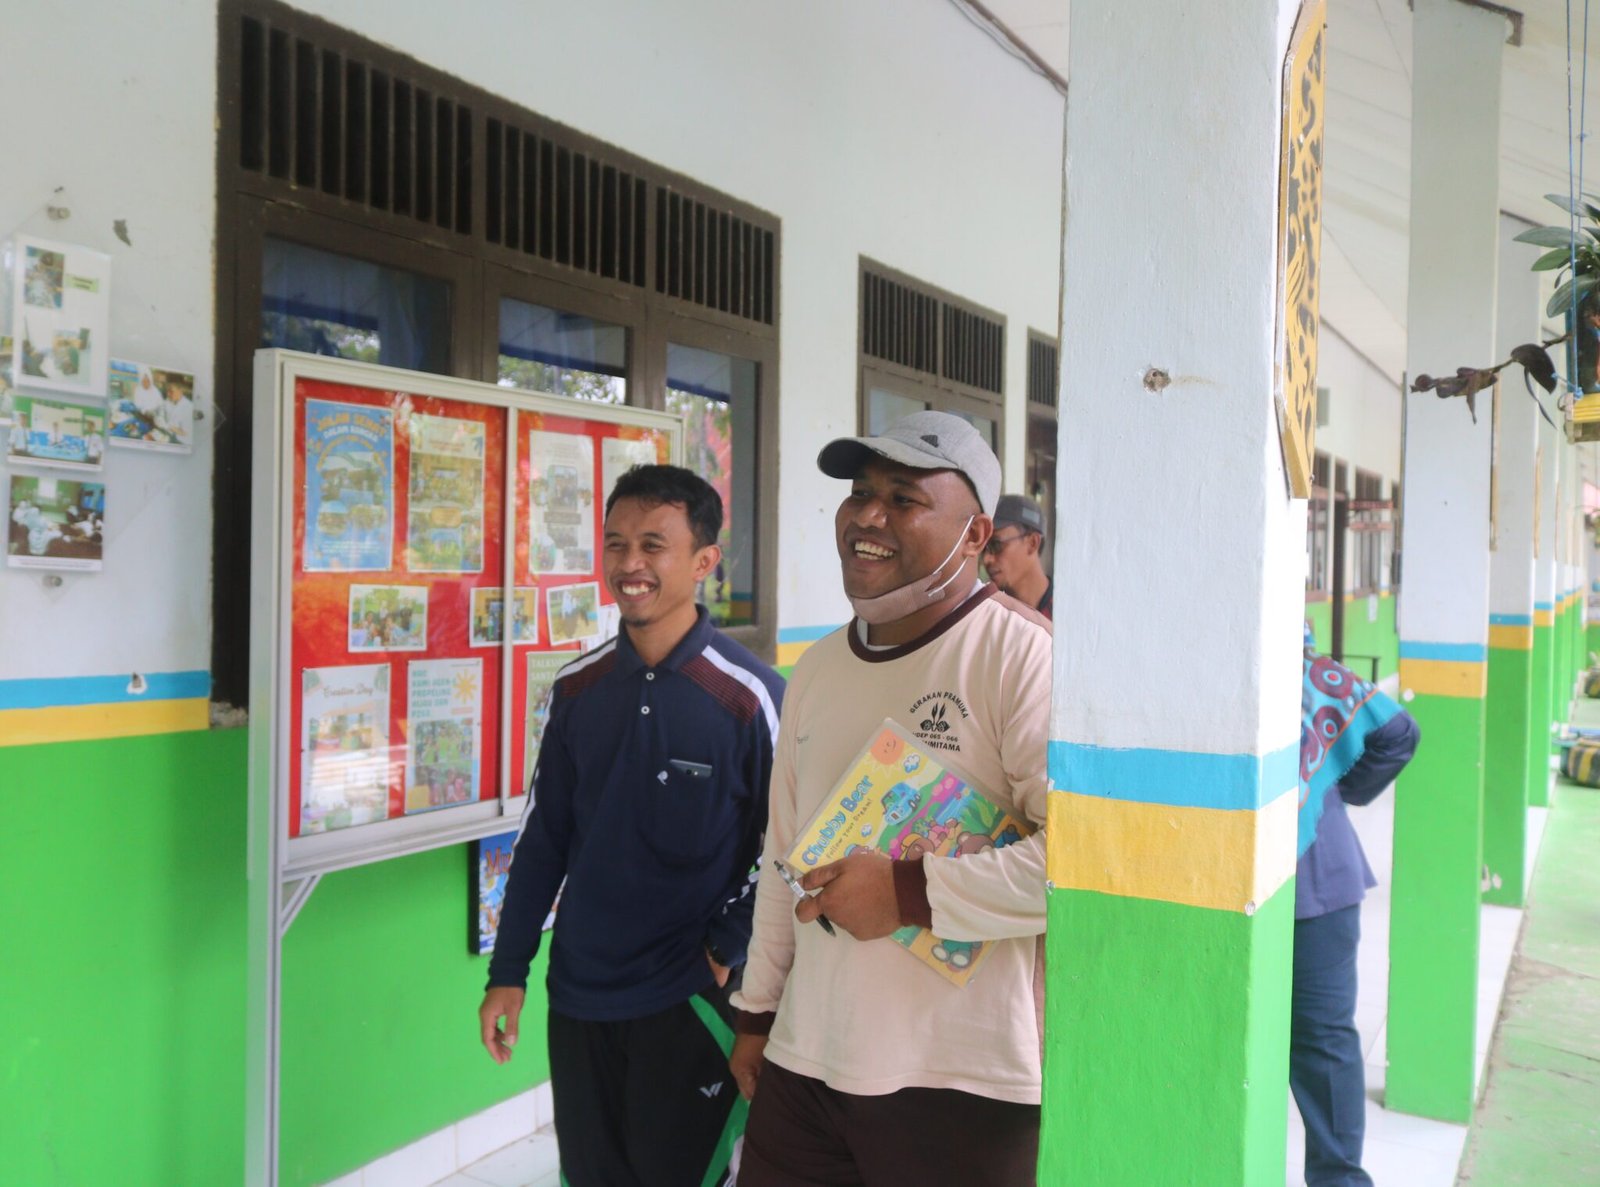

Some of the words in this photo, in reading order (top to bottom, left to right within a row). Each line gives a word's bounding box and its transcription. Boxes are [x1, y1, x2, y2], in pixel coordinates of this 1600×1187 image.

[910, 691, 942, 714] GERAKAN
[943, 691, 969, 719] PRAMUKA
[802, 811, 846, 865] Chubby
[840, 775, 873, 813] Bear
[825, 838, 843, 859] Follow
